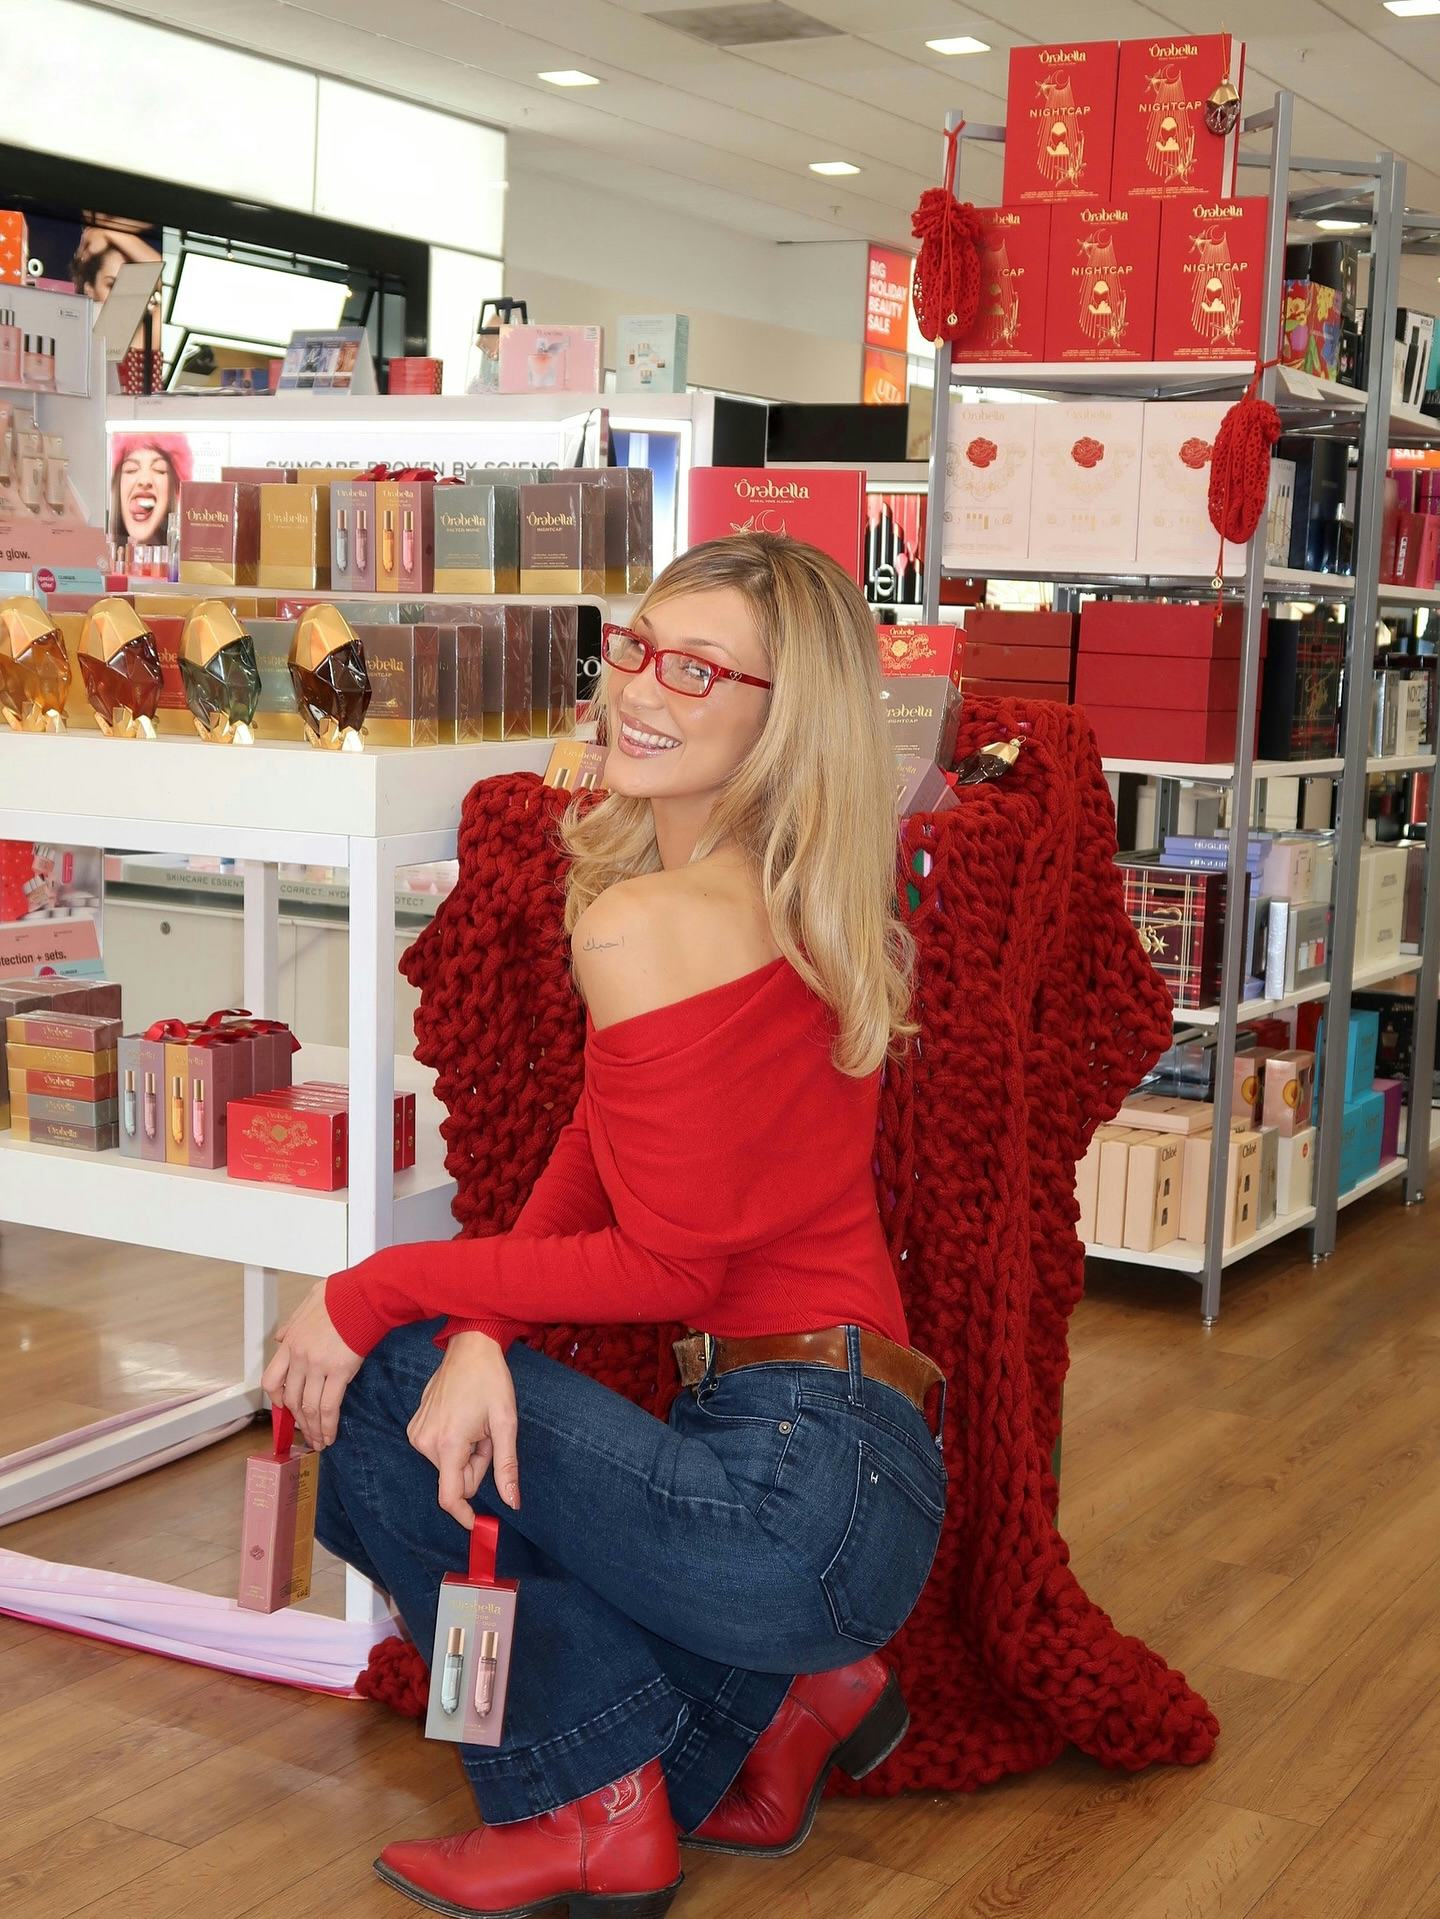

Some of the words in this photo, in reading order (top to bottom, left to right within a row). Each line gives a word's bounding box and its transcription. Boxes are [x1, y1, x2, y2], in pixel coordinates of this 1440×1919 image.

[1029, 106, 1091, 118] NIGHTCAP
[1139, 100, 1202, 113] NIGHTCAP
[869, 260, 886, 278] BIG
[1071, 265, 1133, 277] NIGHTCAP
[1182, 262, 1248, 273] NIGHTCAP
[869, 278, 908, 301] HOLIDAY
[868, 296, 903, 319] BEAUTY
[867, 314, 891, 335] SALE
[6, 548, 30, 560] glow.
[166, 872, 208, 885] SKINCARE
[44, 949, 67, 961] sets.
